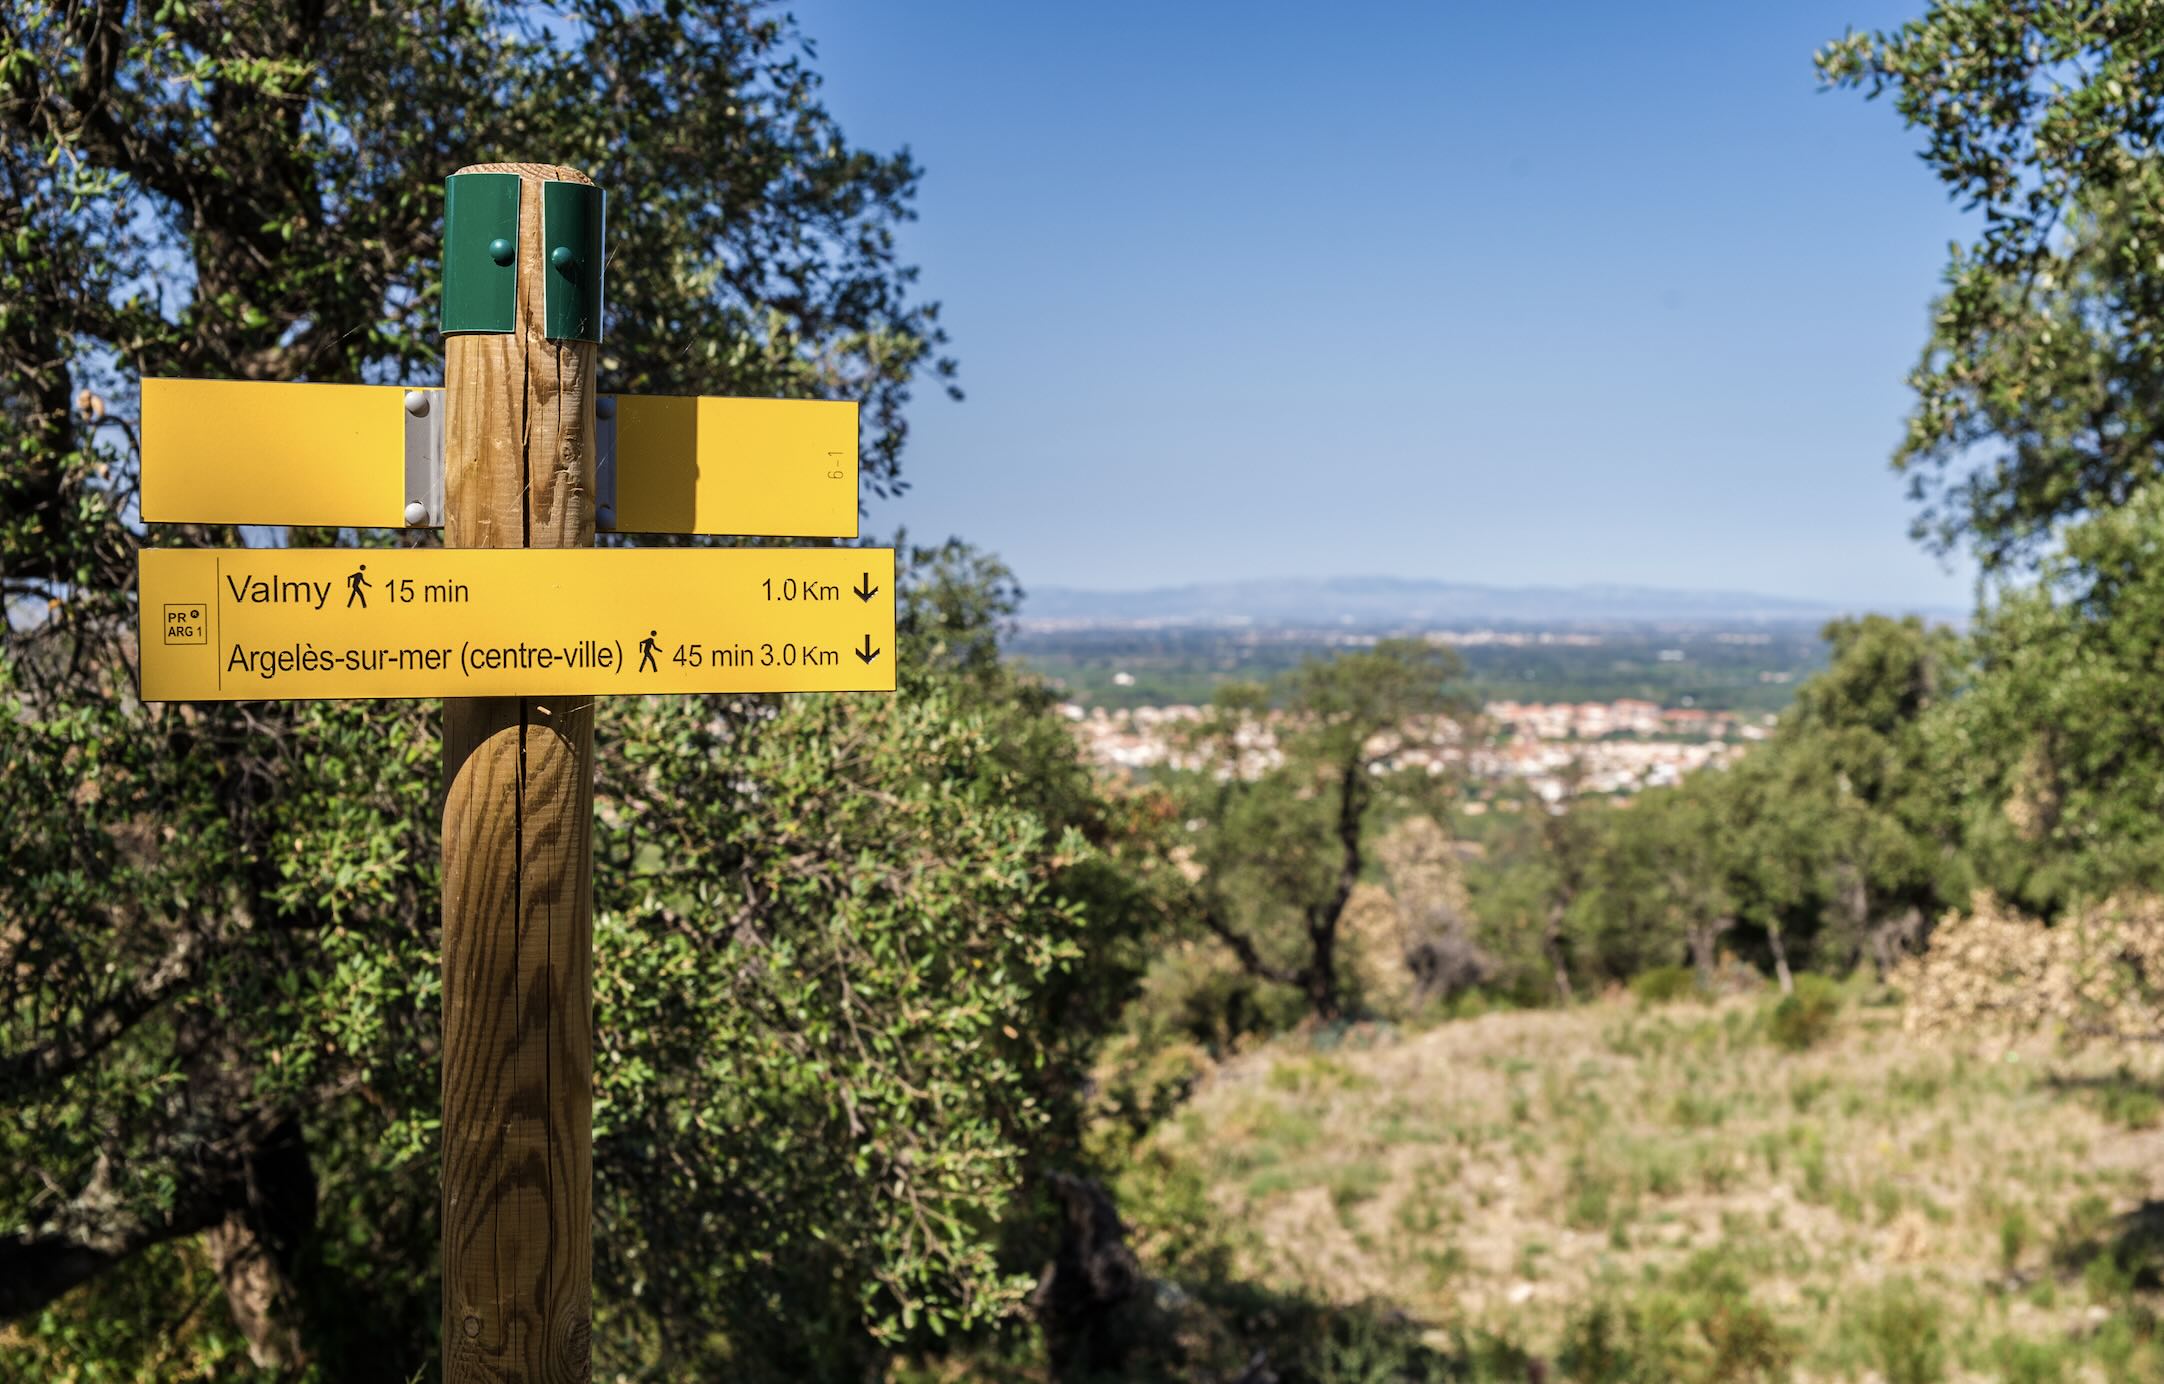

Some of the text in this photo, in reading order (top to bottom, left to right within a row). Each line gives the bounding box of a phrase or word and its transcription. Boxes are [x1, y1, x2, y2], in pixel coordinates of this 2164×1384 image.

[226, 574, 839, 611] Valmy 15 min 1.0 Km
[167, 612, 187, 624] PR
[167, 625, 202, 638] ARG 1
[226, 639, 839, 680] Argelès-sur-mer (centre-ville) 45 min 3.0 Km
